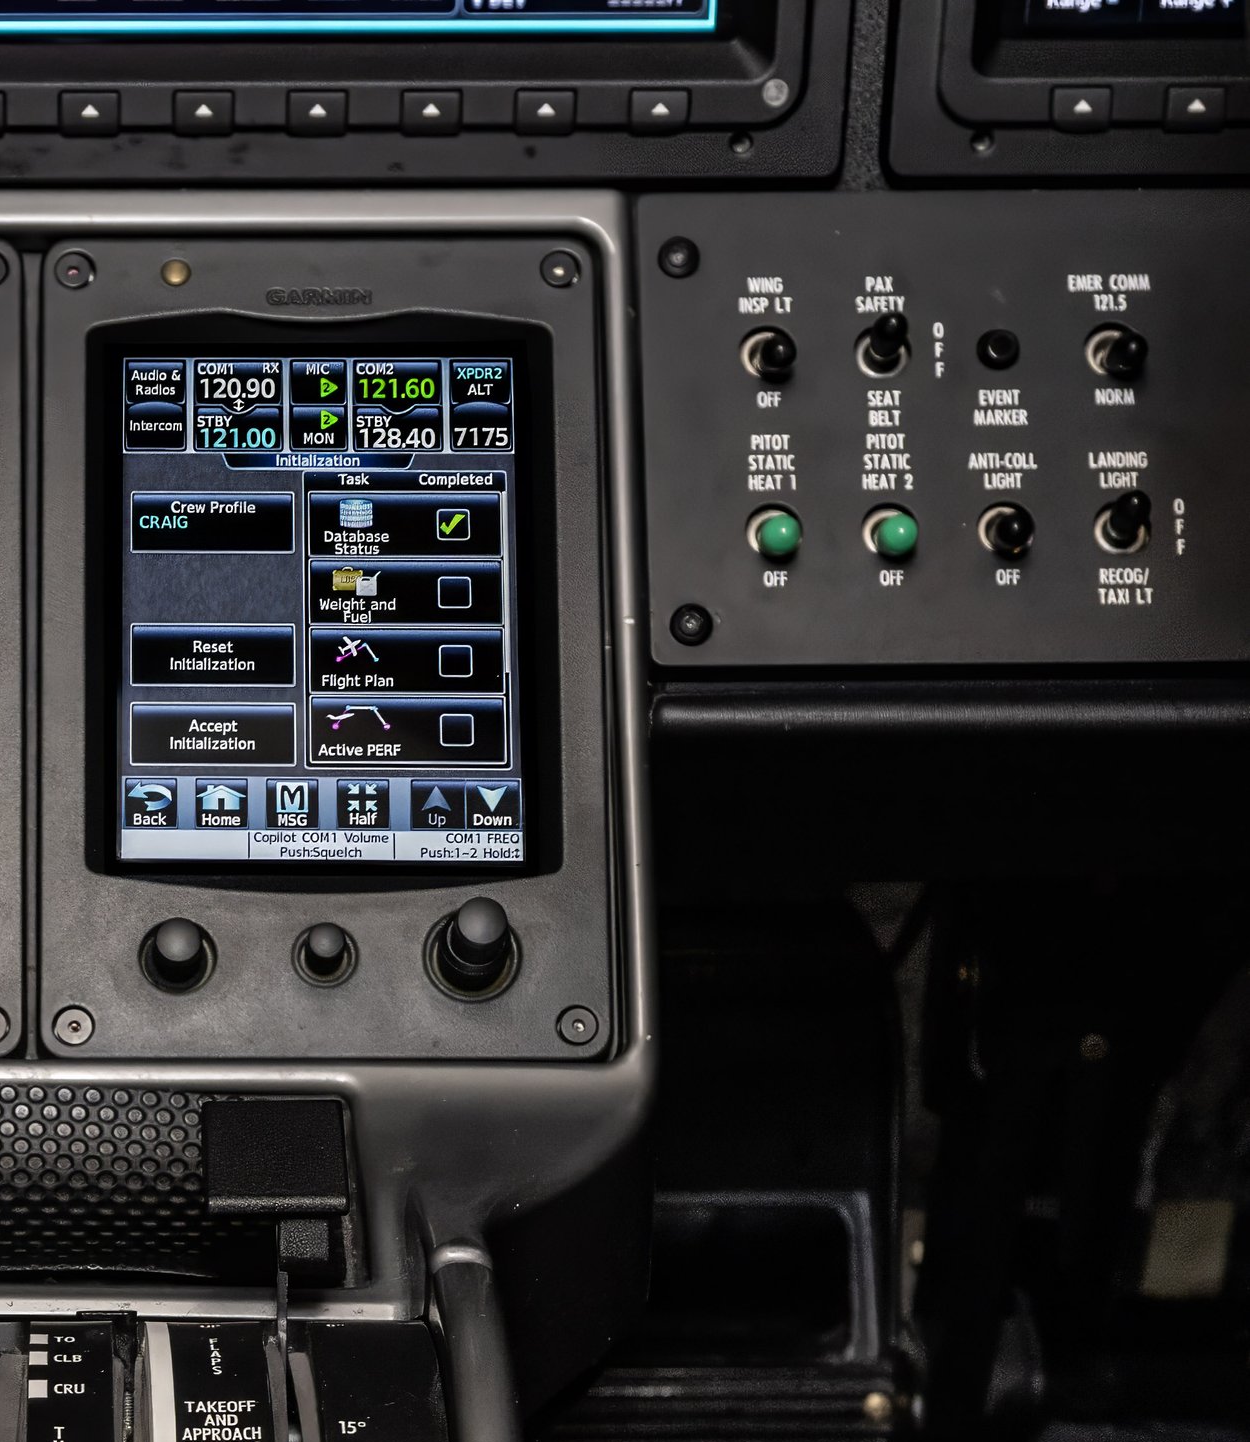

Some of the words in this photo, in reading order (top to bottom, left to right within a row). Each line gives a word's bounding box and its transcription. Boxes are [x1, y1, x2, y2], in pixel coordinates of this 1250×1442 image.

[747, 278, 783, 293] WING
[865, 277, 894, 292] PAX
[1067, 274, 1104, 291] EMER
[1109, 274, 1150, 291] COMM
[738, 297, 769, 313] INSP
[774, 297, 793, 313] LT
[855, 296, 905, 313] SAFETY
[1093, 295, 1127, 310] 121.5
[933, 322, 945, 377] OFF
[756, 392, 781, 407] OFF
[867, 391, 901, 406] SEAT
[978, 390, 1020, 406] EVENT
[1094, 389, 1135, 405] NORM
[868, 410, 900, 426] BELT
[973, 409, 1028, 425] MARKER
[751, 434, 790, 450] PITOT
[276, 454, 360, 467] Initialization
[748, 455, 795, 470] STATIC
[968, 453, 1037, 469] ANTI-COLL
[1088, 452, 1148, 468] LANDING
[338, 473, 369, 486] Task
[419, 473, 493, 489] Completed
[747, 474, 781, 490] HEAT
[790, 474, 797, 490] 1
[983, 473, 1022, 488] LIGHT
[1099, 472, 1139, 487] LIGHT
[171, 501, 206, 514] Crew
[210, 501, 256, 514] Profile
[139, 515, 188, 529] CRAIG
[1174, 499, 1185, 554] OFF
[324, 530, 389, 544] Database
[335, 542, 380, 555] Status
[1099, 568, 1150, 585] RECOG/
[1098, 588, 1129, 604] TAXI
[1135, 589, 1153, 604] LT
[320, 598, 366, 614] Weight
[371, 599, 396, 611] and
[344, 611, 372, 623] Fuel
[193, 641, 233, 654] Reset
[189, 720, 238, 735] Accept
[209, 1338, 223, 1375] FLAPS
[185, 1401, 256, 1413] TAKEOFF
[205, 1414, 239, 1427] AND
[339, 1420, 367, 1435] 15°
[182, 1427, 262, 1440] APPROACH
